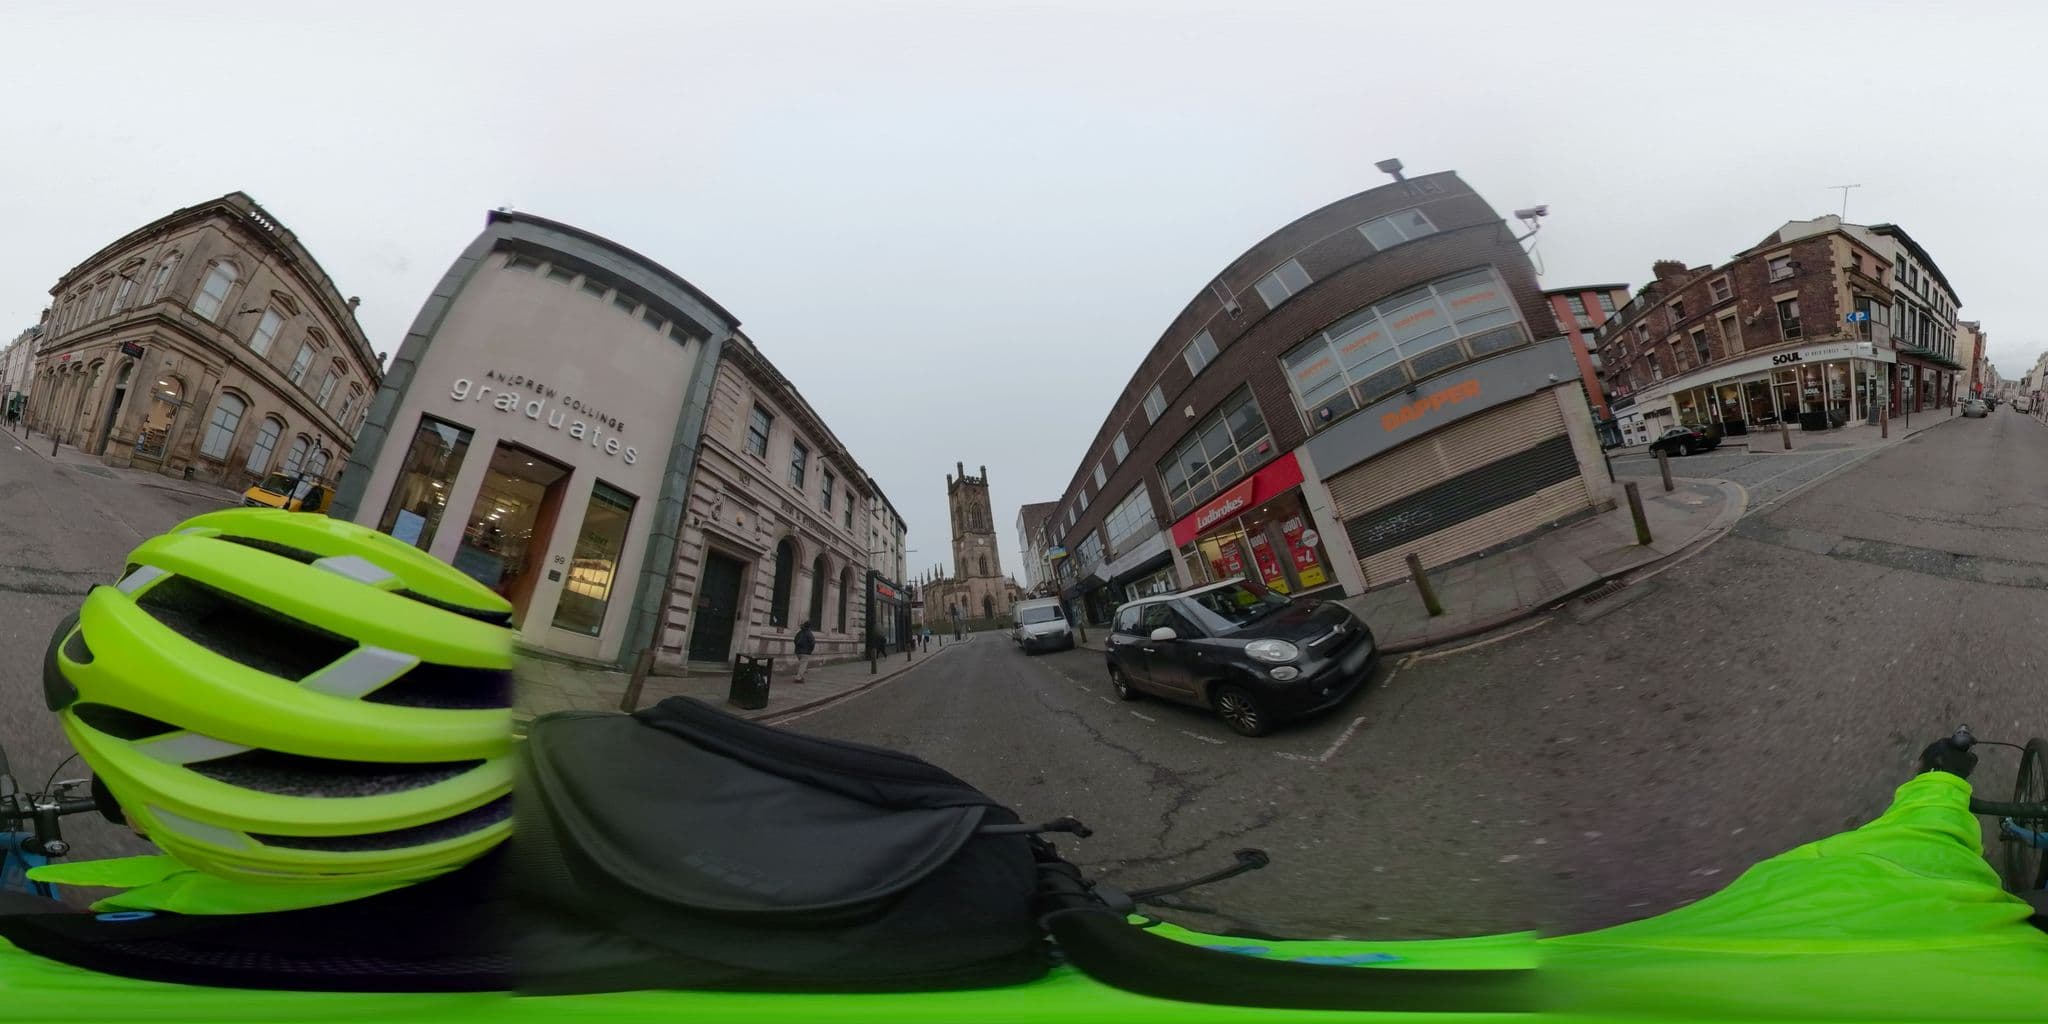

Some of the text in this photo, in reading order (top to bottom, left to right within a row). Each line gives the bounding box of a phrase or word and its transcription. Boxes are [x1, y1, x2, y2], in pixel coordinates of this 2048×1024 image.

[1772, 351, 1802, 365] SOUL
[450, 377, 638, 465] graduates
[486, 370, 625, 433] ANDREW COLLINGE
[1381, 379, 1481, 432] DAPPER
[1197, 496, 1244, 531] Ladbrokes
[554, 554, 565, 565] 99
